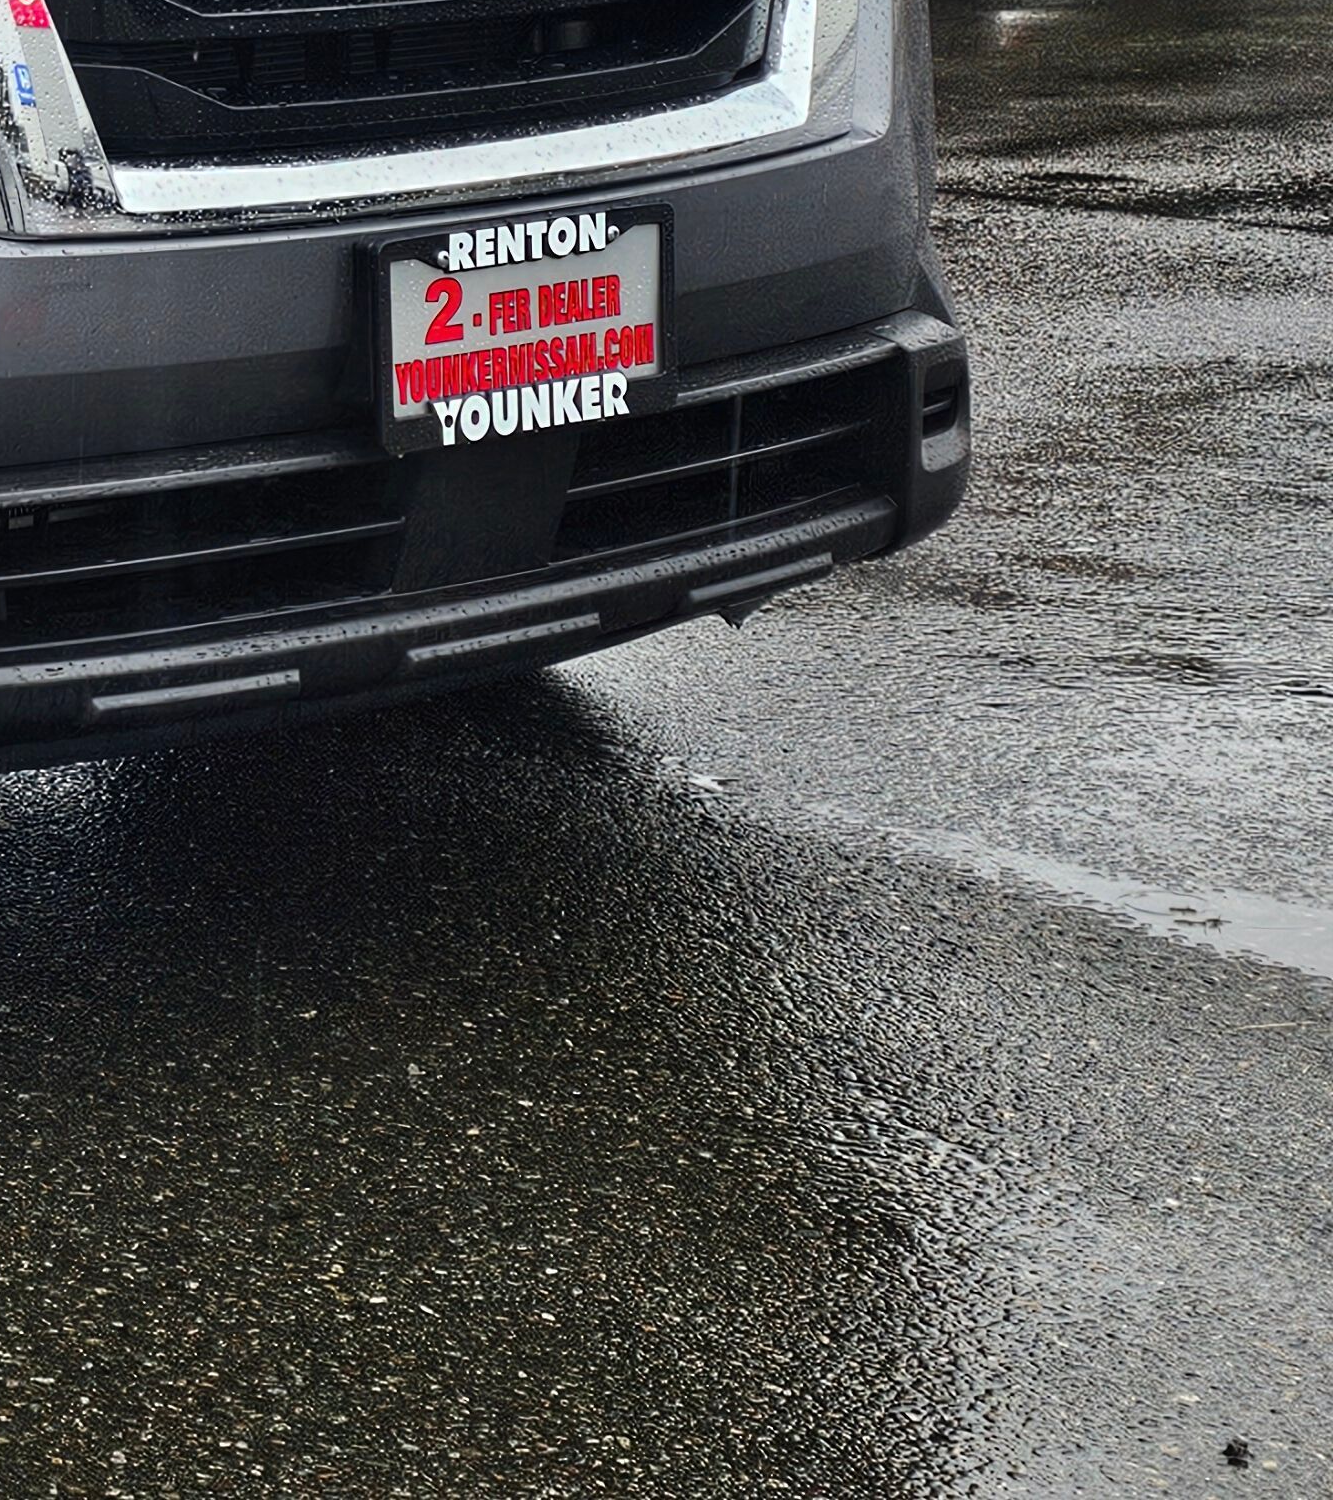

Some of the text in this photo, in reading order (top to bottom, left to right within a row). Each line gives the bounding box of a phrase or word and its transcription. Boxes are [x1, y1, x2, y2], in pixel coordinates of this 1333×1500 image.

[449, 211, 608, 272] RENTON
[424, 276, 465, 345] 2
[489, 288, 532, 336] FER
[538, 274, 621, 328] DEALER
[395, 322, 654, 405] YOUNKERNISSAN.COM
[434, 372, 631, 446] YOUNKER
